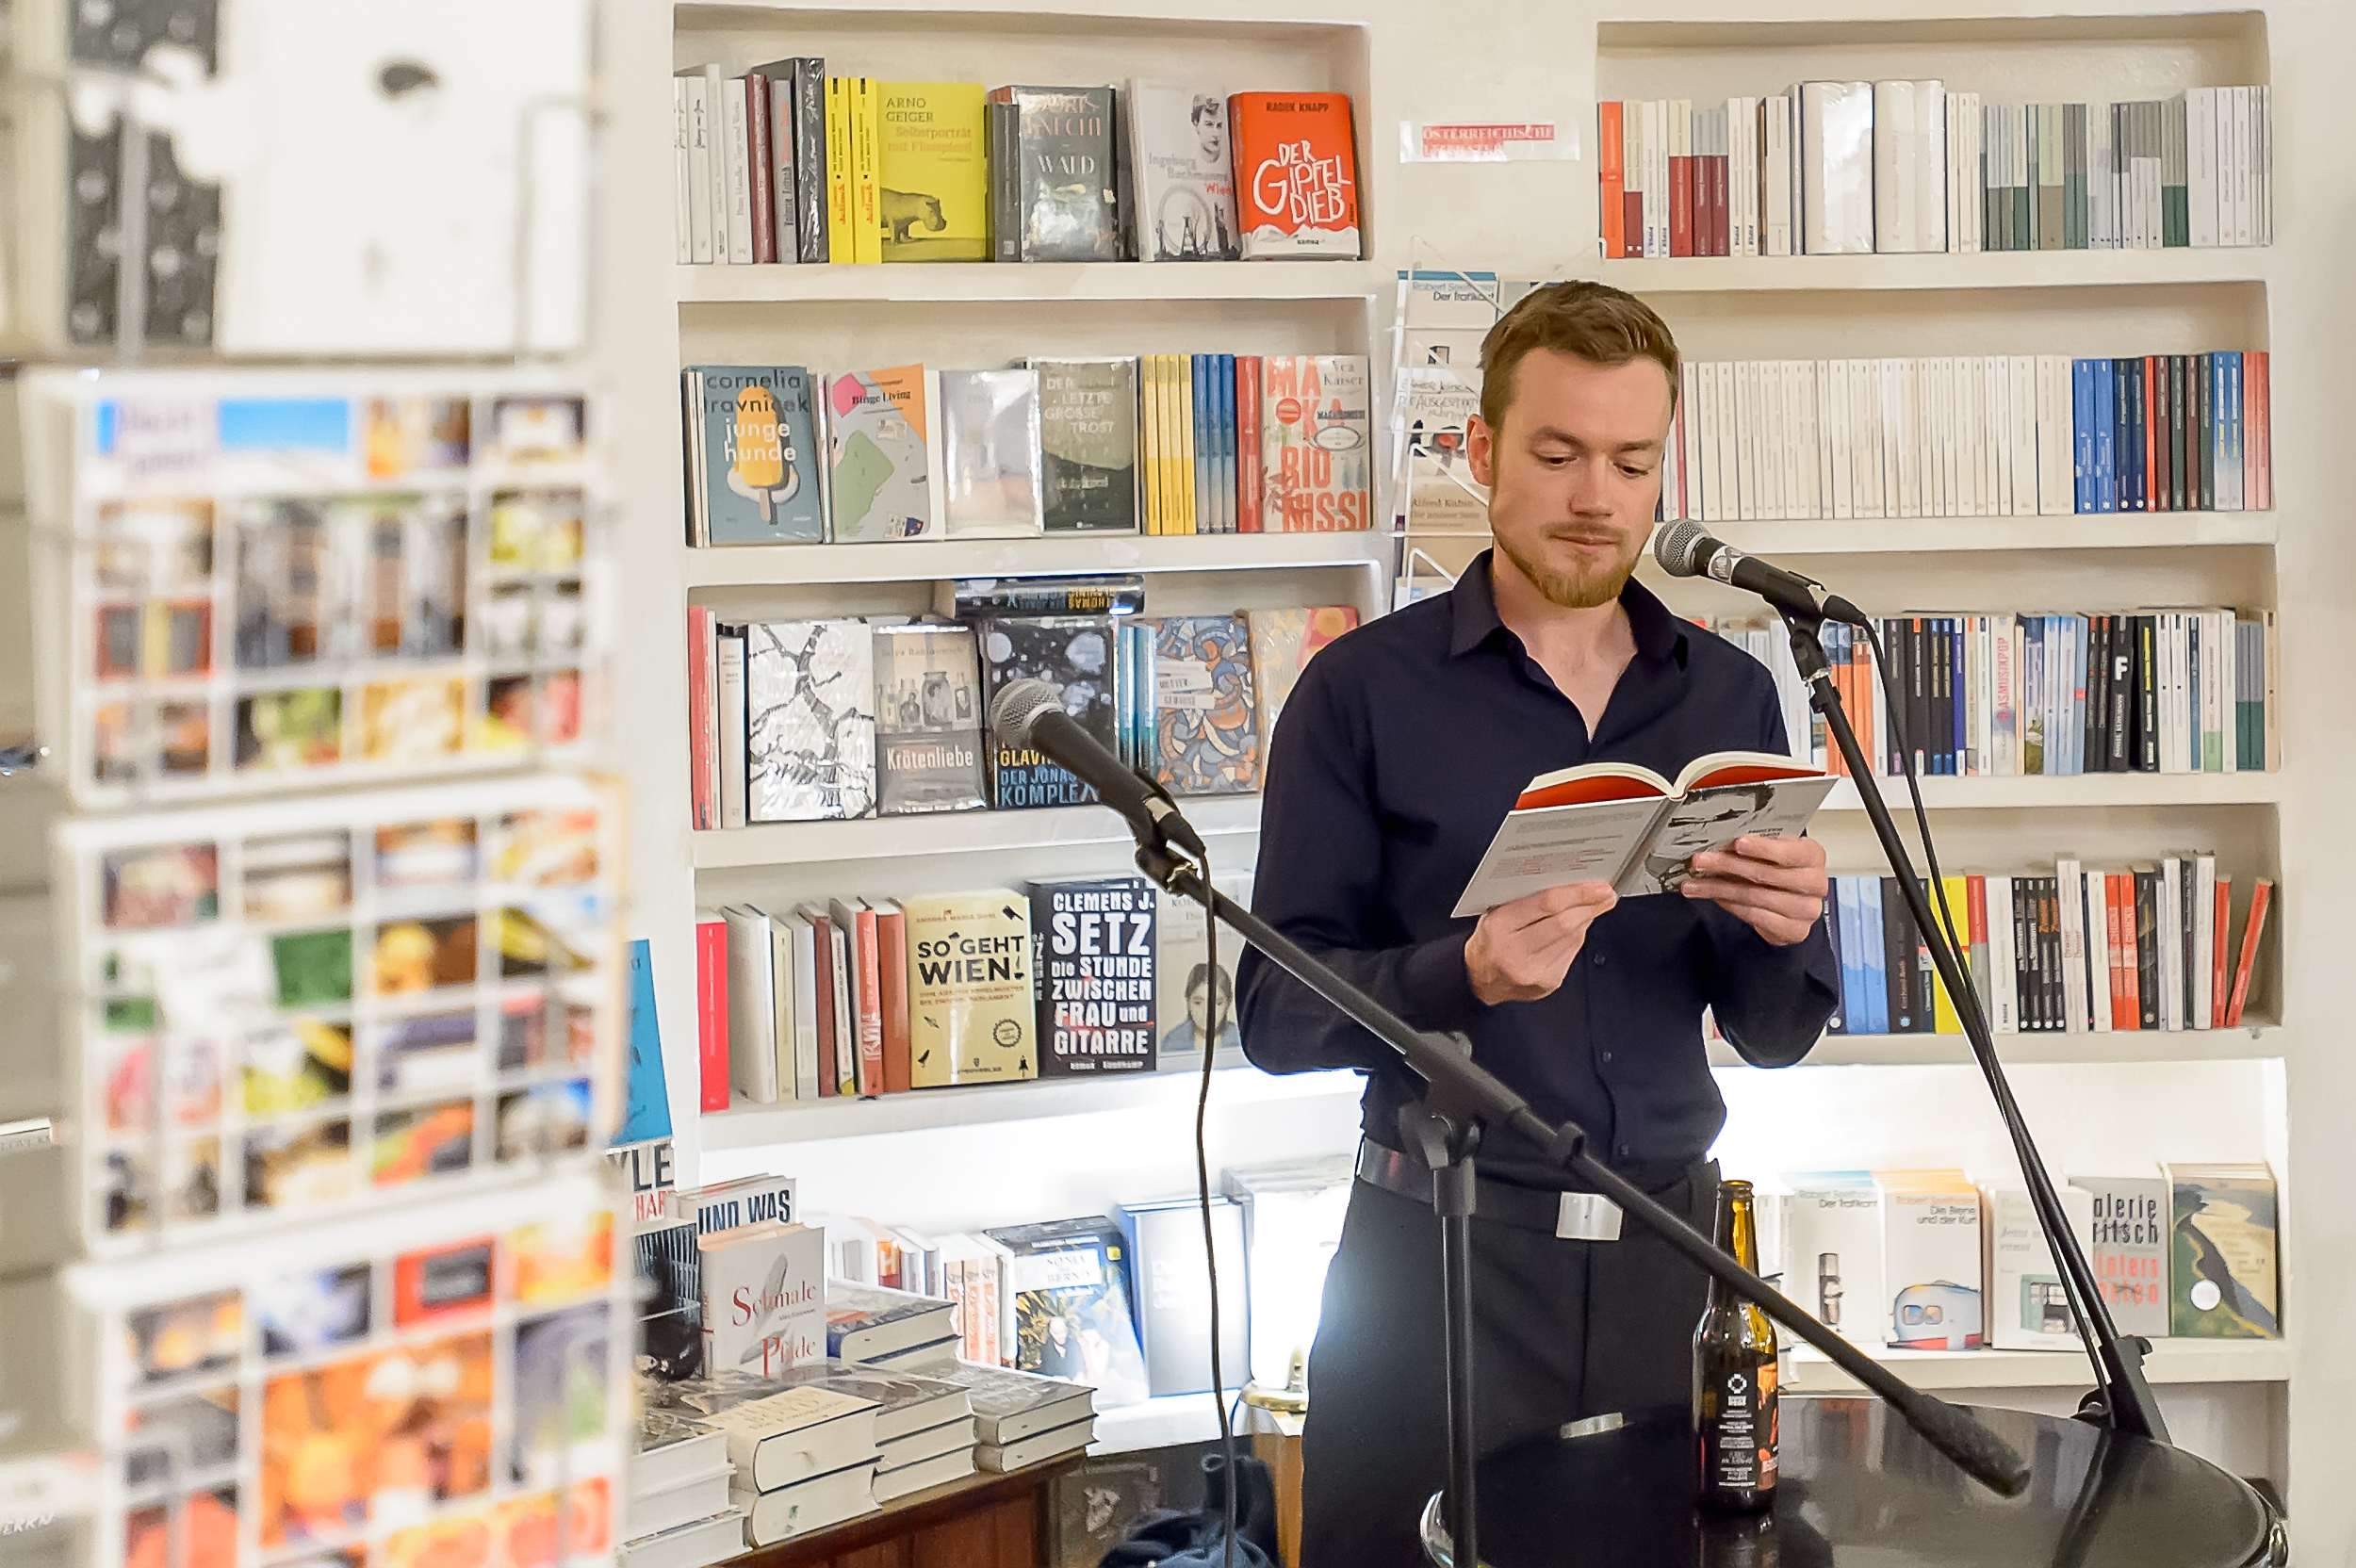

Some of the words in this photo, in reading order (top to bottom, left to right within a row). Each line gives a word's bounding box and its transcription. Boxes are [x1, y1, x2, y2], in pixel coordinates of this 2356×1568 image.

[886, 97, 926, 108] ARNO
[886, 111, 934, 122] GEIGER
[1278, 139, 1317, 167] DER
[1252, 155, 1351, 216] GIPFEL
[1289, 187, 1346, 225] DIEB
[706, 368, 801, 389] cornelia
[725, 417, 792, 443] junge
[724, 440, 796, 462] hunde
[886, 743, 973, 771] Krötenliebe
[1000, 769, 1028, 786] DER
[1053, 891, 1134, 912] CLEMENS
[1137, 890, 1155, 911] J.
[917, 939, 951, 959] SO
[959, 935, 1024, 956] GEHT
[1052, 912, 1151, 956] SETZ
[918, 956, 1025, 987] WIEN!
[1080, 956, 1152, 978] STUNDE
[1055, 1002, 1117, 1028] FRAU
[1119, 1004, 1149, 1023] und
[1054, 1029, 1149, 1055] GITARRE
[747, 1189, 791, 1224] WAS
[2093, 1193, 2157, 1219] alerie
[2092, 1218, 2158, 1244] ritsch
[732, 1279, 817, 1327] Schmale
